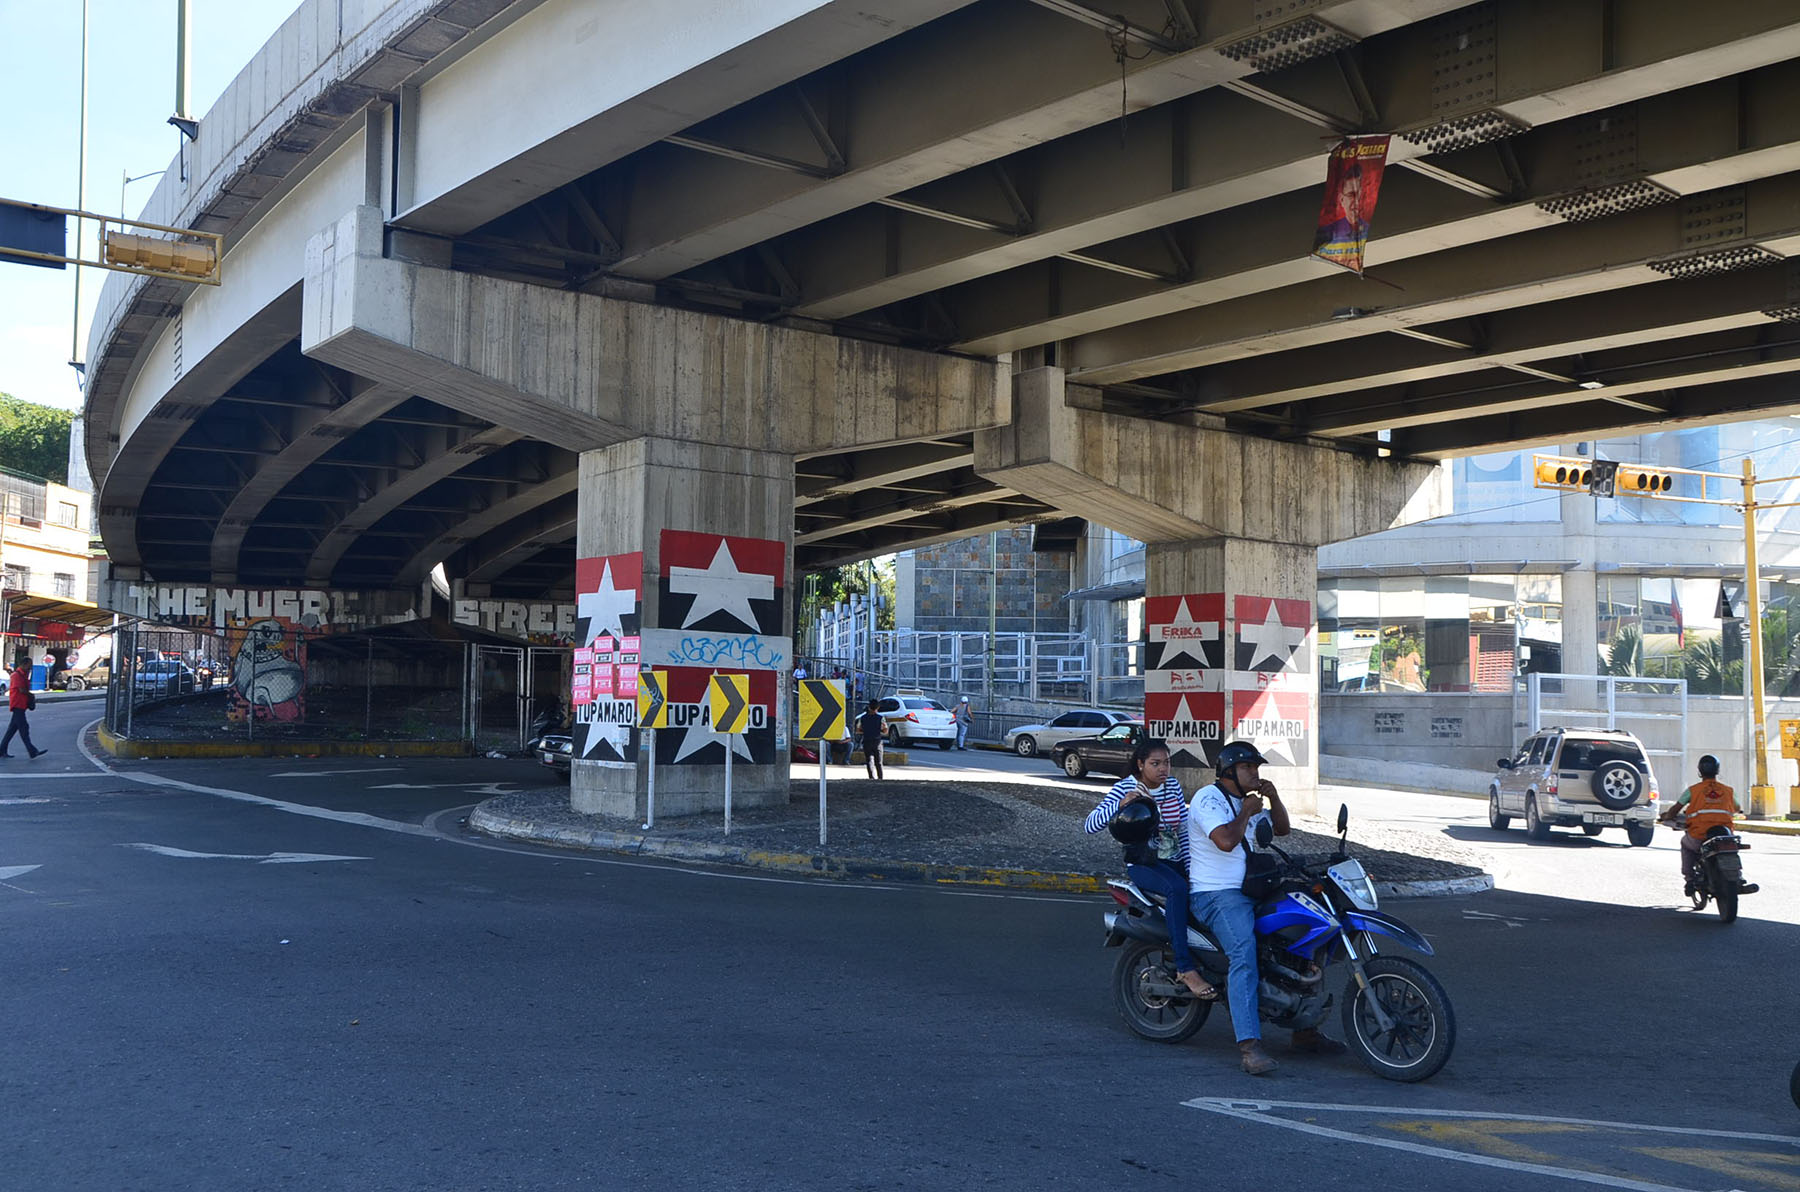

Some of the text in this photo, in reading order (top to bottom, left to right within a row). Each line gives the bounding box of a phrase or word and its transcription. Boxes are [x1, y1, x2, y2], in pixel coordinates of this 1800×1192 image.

[129, 585, 208, 619] THE
[577, 701, 633, 723] TUPAMARO
[667, 704, 764, 727] TUPAO
[1149, 720, 1218, 738] TUPAMARO
[1239, 719, 1302, 738] TUPAMARO
